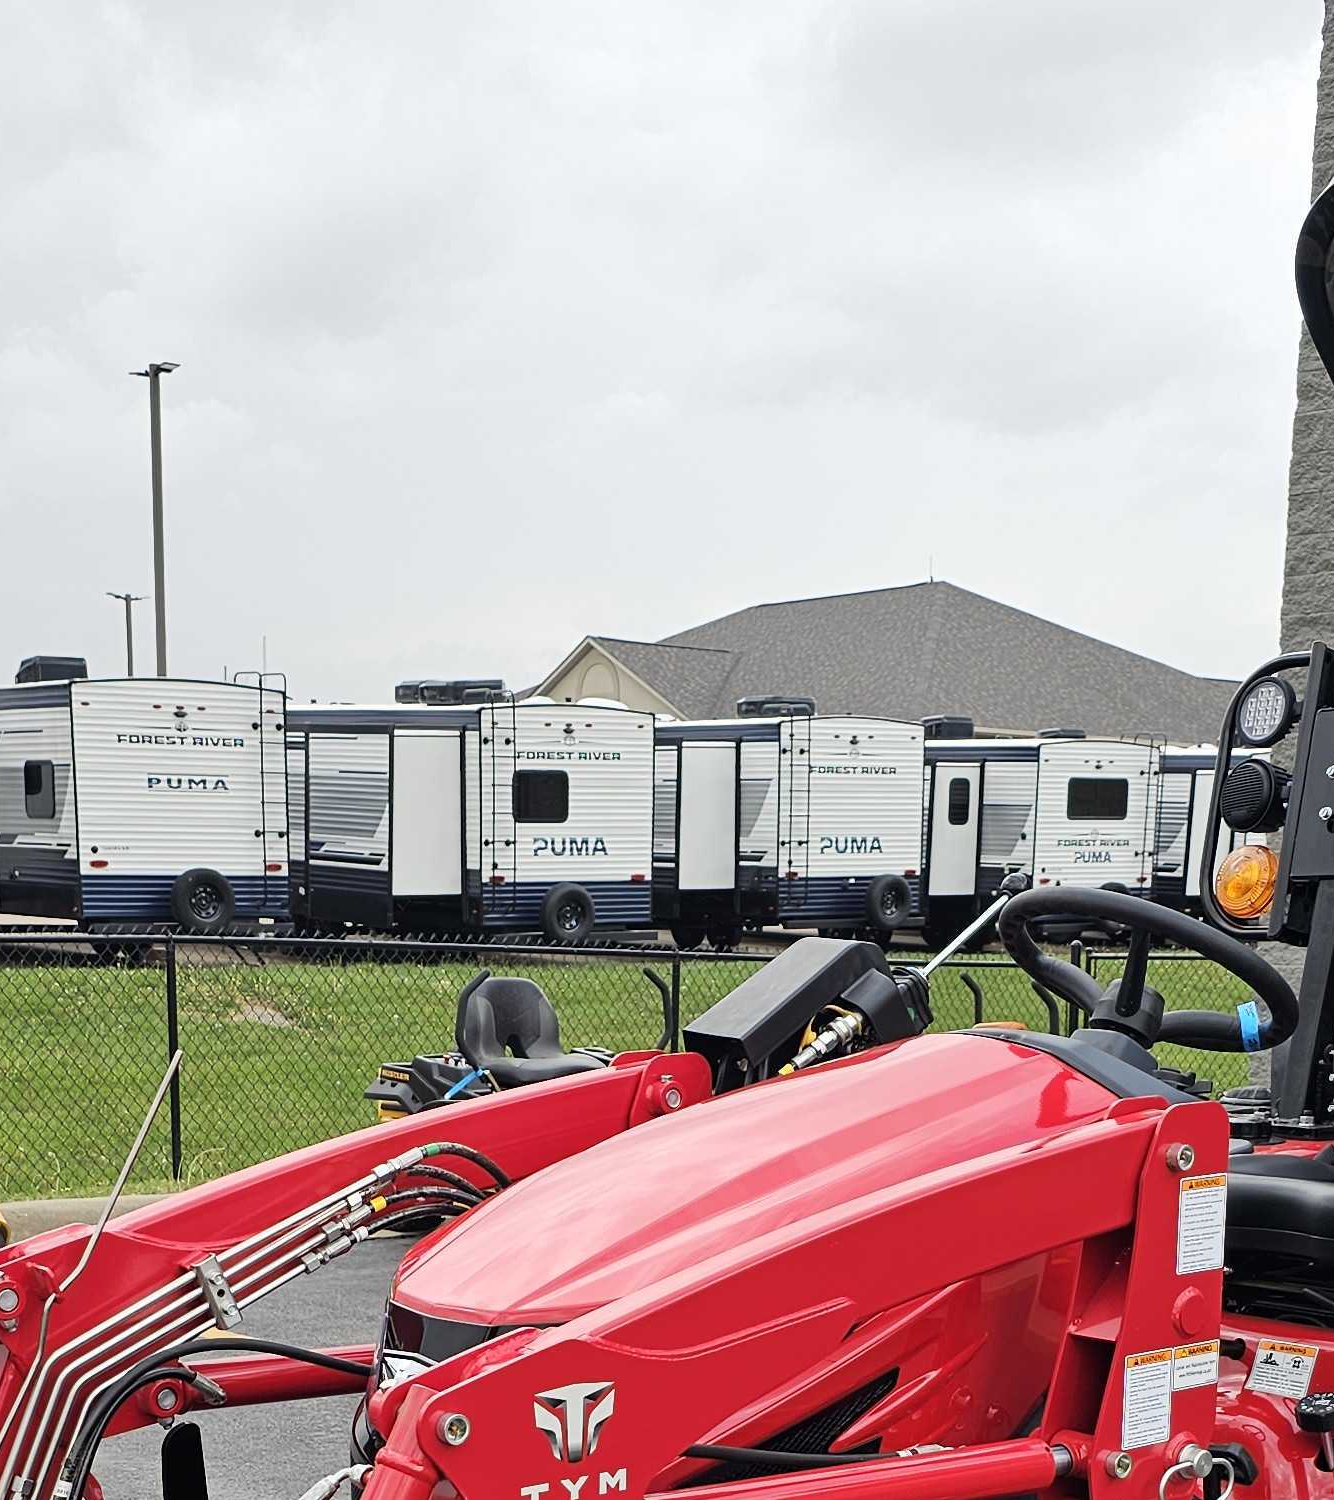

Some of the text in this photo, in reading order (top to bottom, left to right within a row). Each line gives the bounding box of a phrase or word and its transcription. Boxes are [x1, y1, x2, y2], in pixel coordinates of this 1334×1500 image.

[117, 734, 244, 747] FOREST RIVER
[517, 751, 621, 761] FOREST RIVER
[147, 777, 230, 791] PUMA
[532, 836, 609, 857] PUMA
[820, 836, 883, 855] PUMA
[1074, 851, 1112, 864] PUMA
